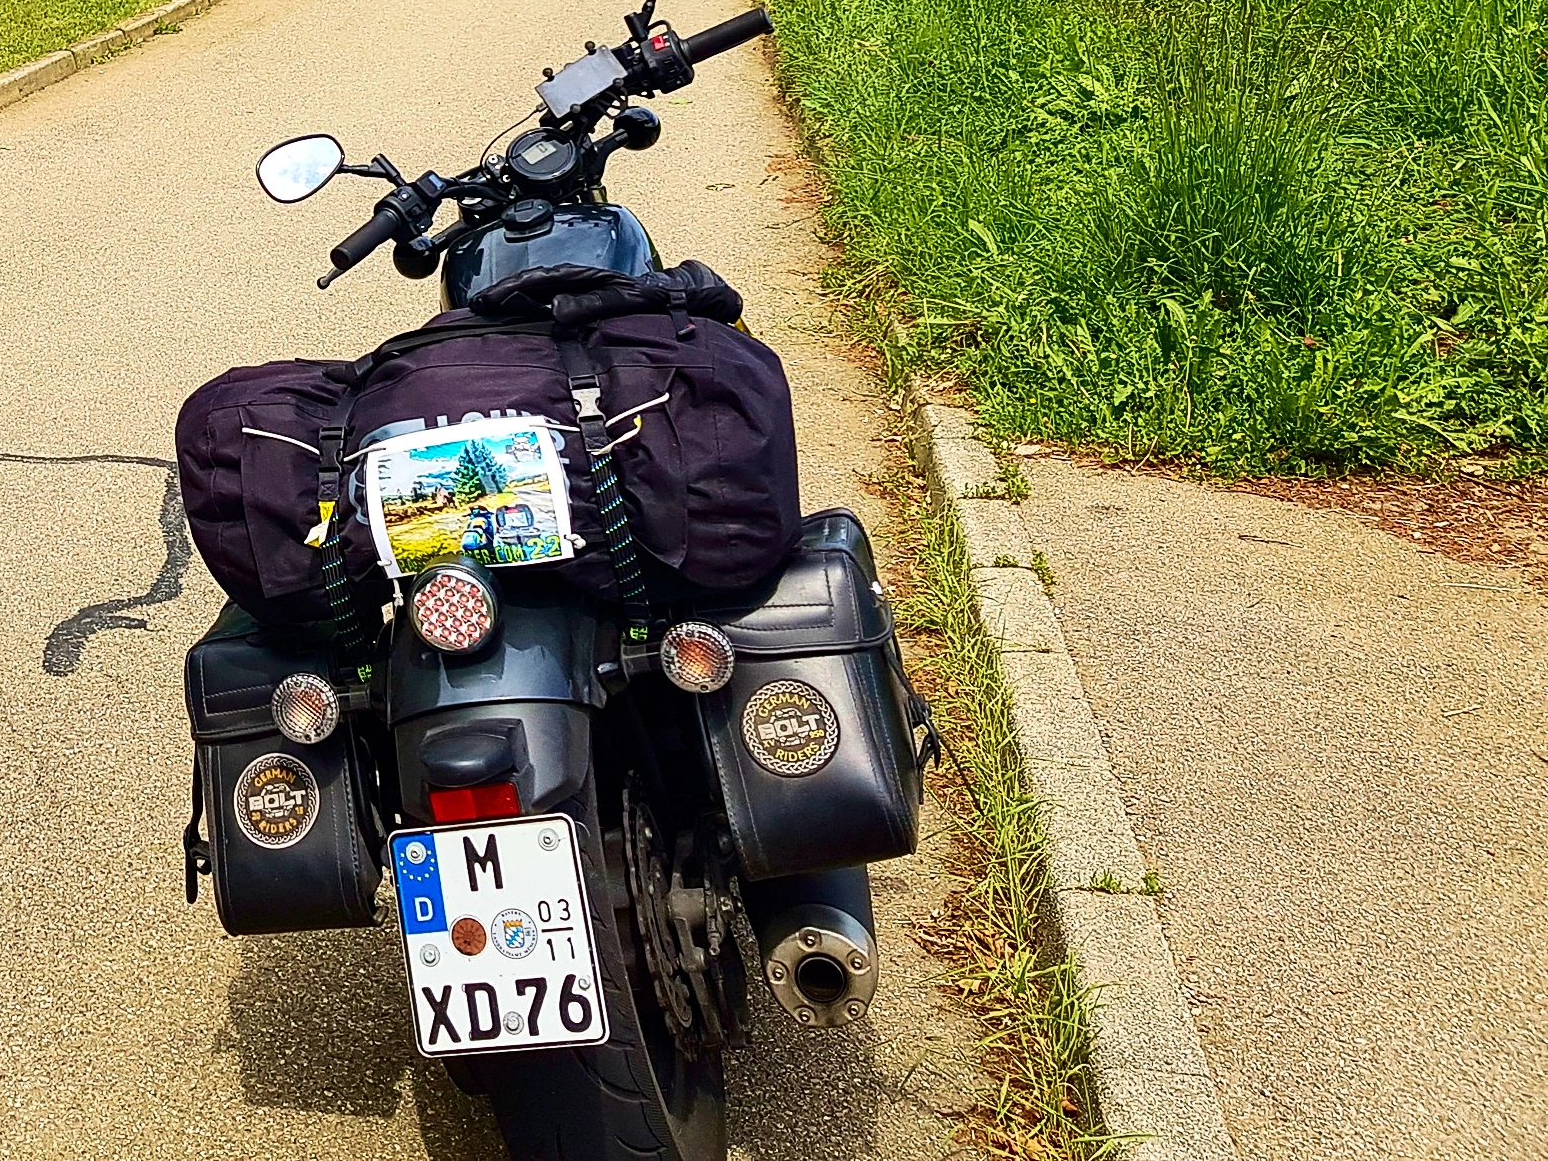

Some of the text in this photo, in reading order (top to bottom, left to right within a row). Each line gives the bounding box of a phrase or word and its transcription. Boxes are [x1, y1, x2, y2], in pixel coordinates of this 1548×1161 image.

[758, 693, 811, 717] GERMAN
[757, 714, 820, 740] BOLT
[775, 741, 820, 761] RIDERS
[254, 768, 297, 787] GERMAN
[248, 789, 306, 812] BOLT
[258, 817, 297, 834] RIDERS
[462, 833, 503, 892] M
[414, 897, 434, 922] D
[537, 899, 571, 923] 03
[546, 937, 576, 962] 11
[421, 974, 592, 1046] XD 76
